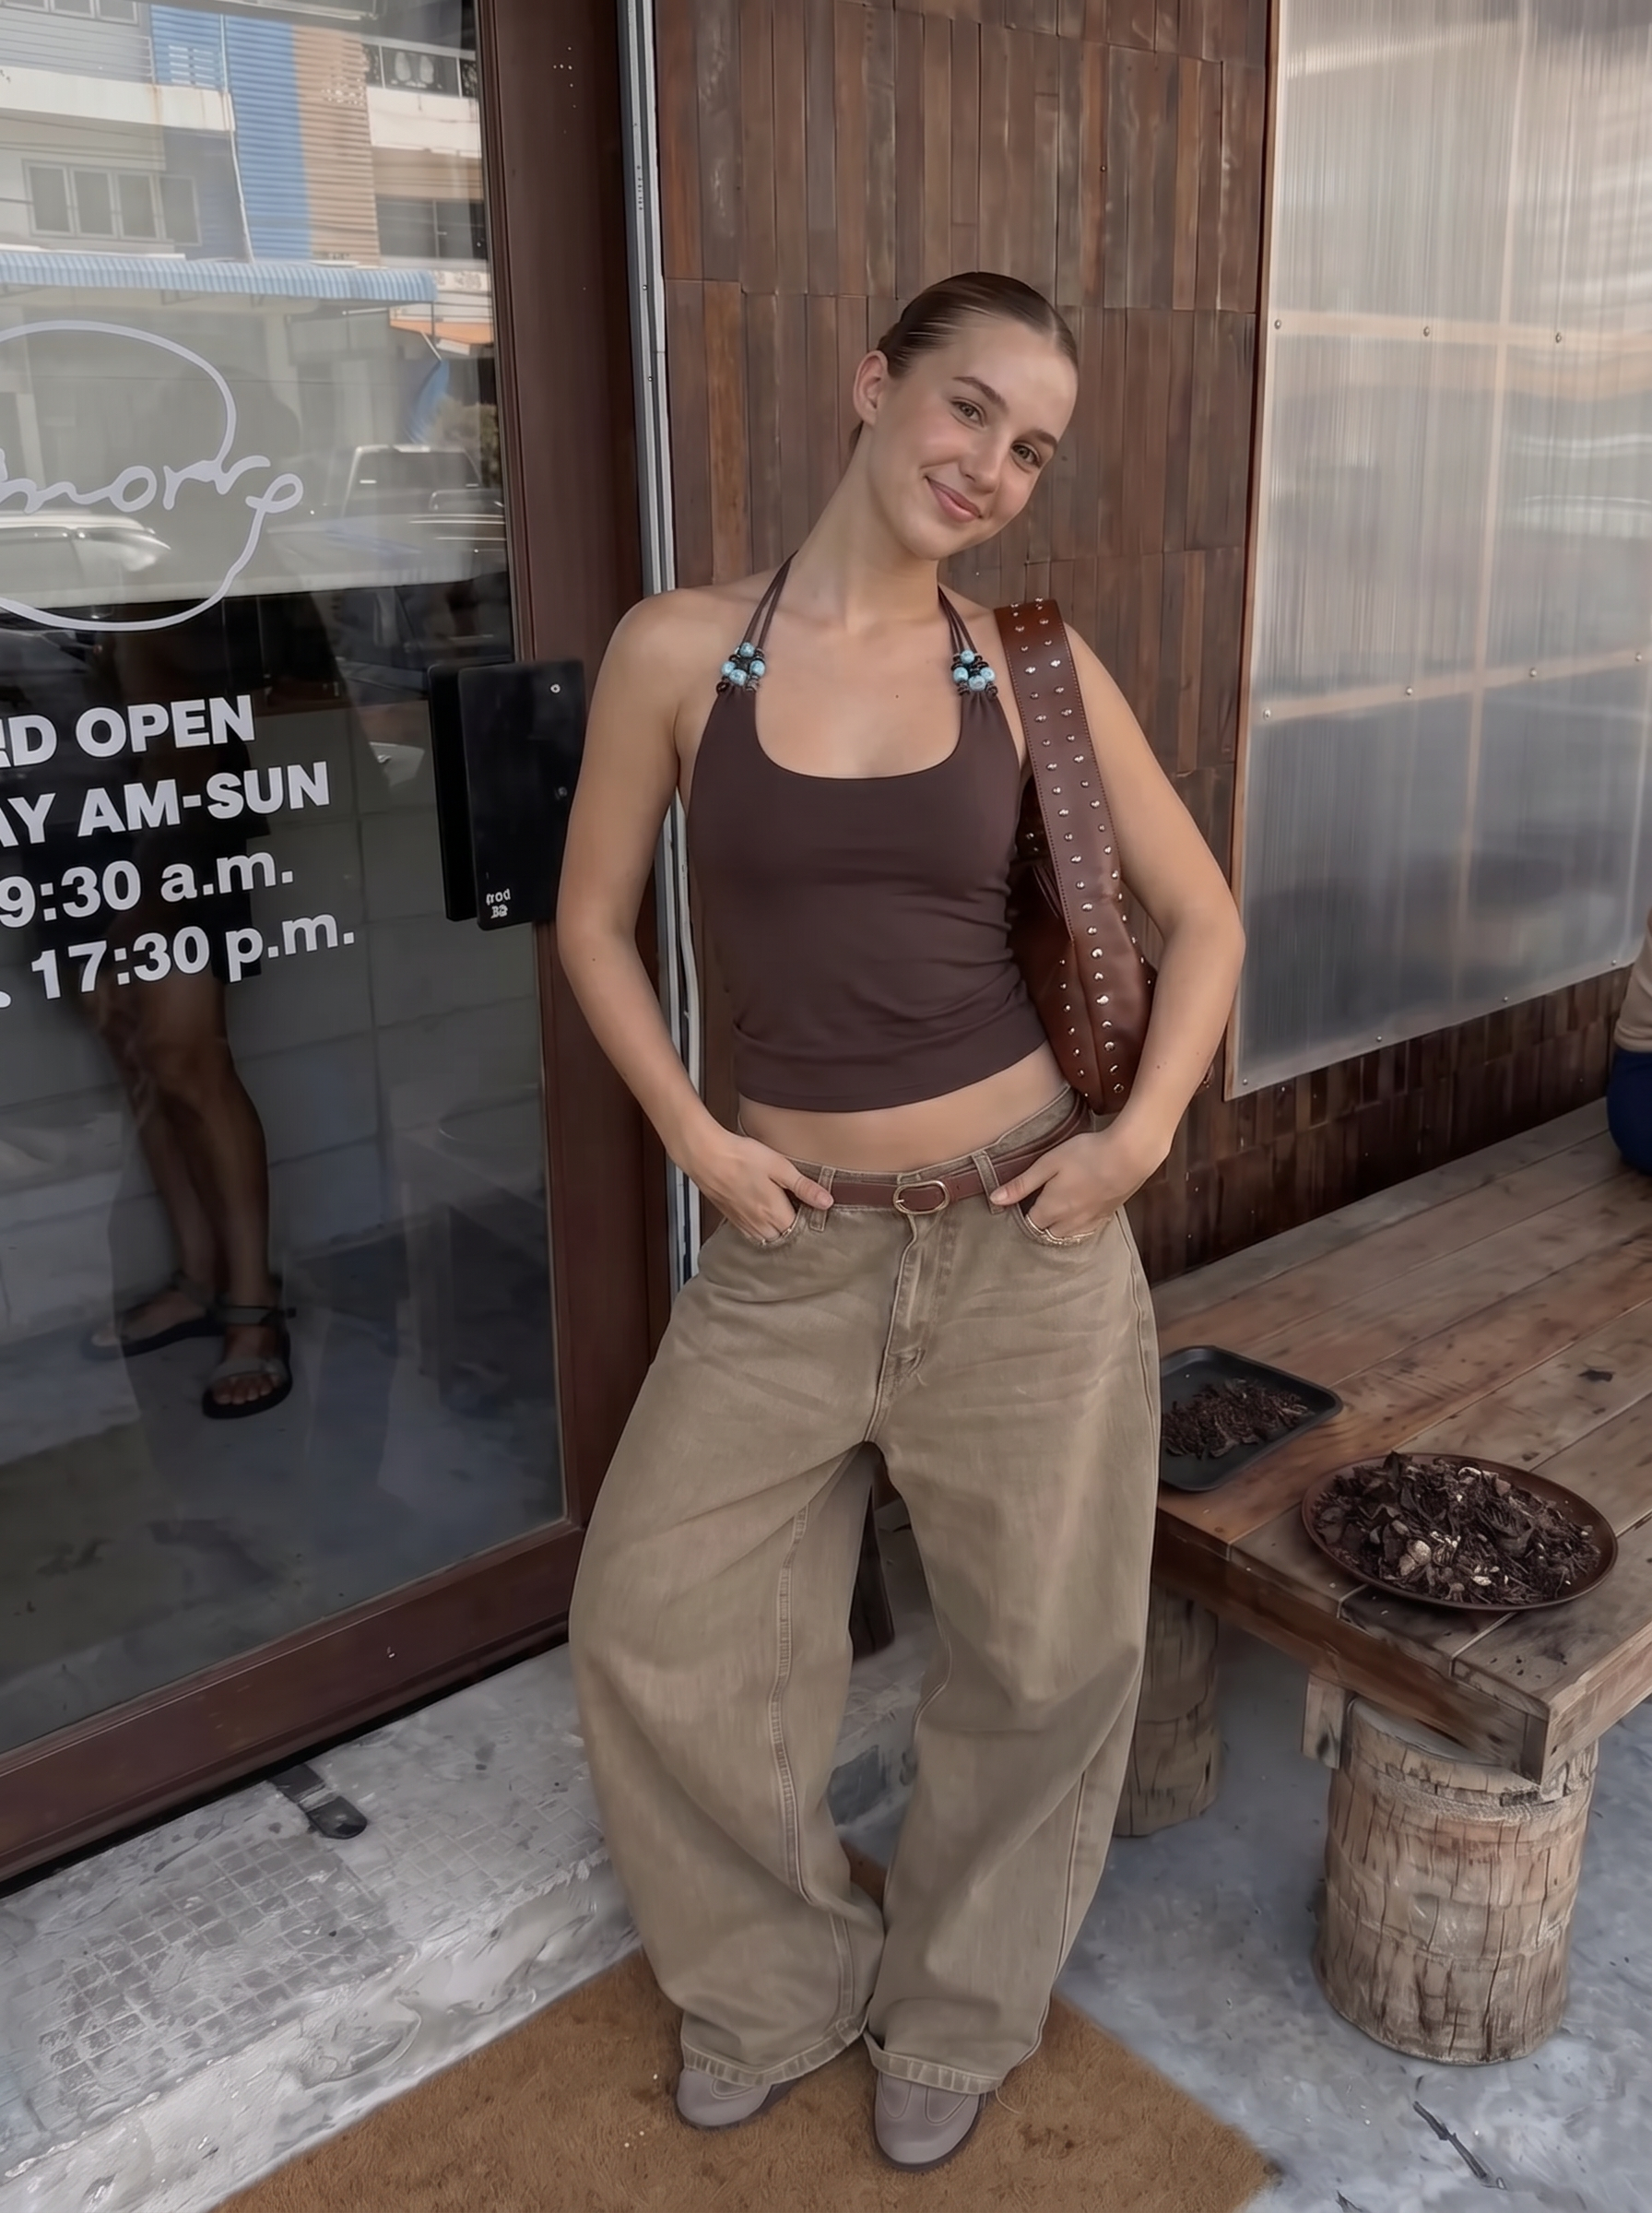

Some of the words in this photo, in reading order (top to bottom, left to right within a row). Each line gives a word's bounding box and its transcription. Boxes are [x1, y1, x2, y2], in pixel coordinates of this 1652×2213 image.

[0, 715, 57, 768] D
[76, 694, 255, 758] OPEN
[77, 761, 330, 837] AM-SUN
[0, 860, 141, 928] 9:30
[160, 852, 293, 902] a.m.
[31, 926, 210, 1000] 17:30
[225, 914, 355, 983] p.m.
